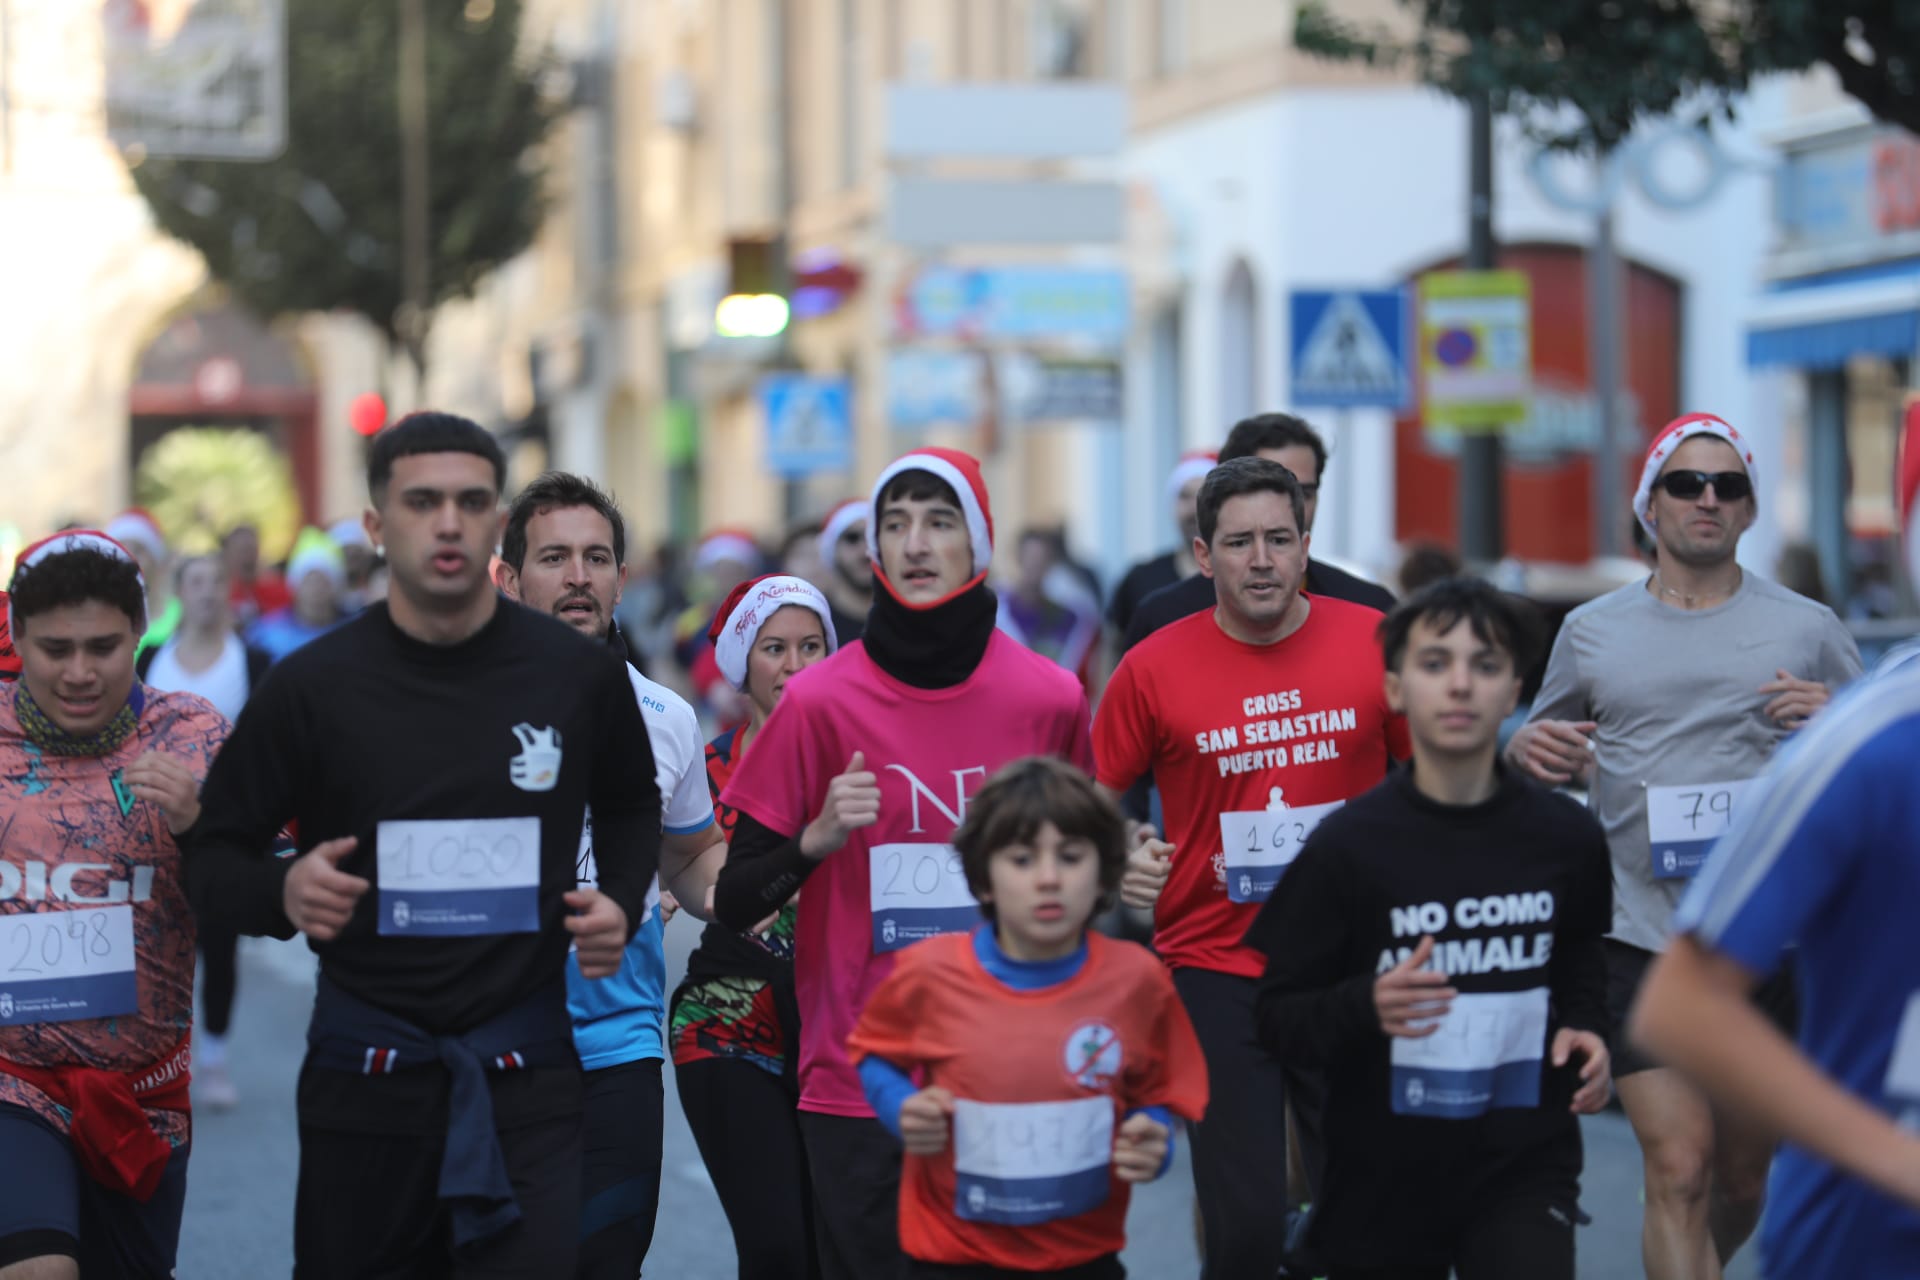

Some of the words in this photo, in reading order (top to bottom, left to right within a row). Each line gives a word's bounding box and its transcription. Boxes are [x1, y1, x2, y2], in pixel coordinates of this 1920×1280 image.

[1243, 689, 1302, 717] CROSS
[1196, 726, 1239, 753] SAN
[1217, 746, 1288, 778] PUERTO
[1292, 739, 1340, 765] REAL
[389, 833, 523, 880] 1050
[1390, 901, 1448, 938] NO
[1454, 891, 1554, 929] COMO
[8, 912, 111, 974] 2098
